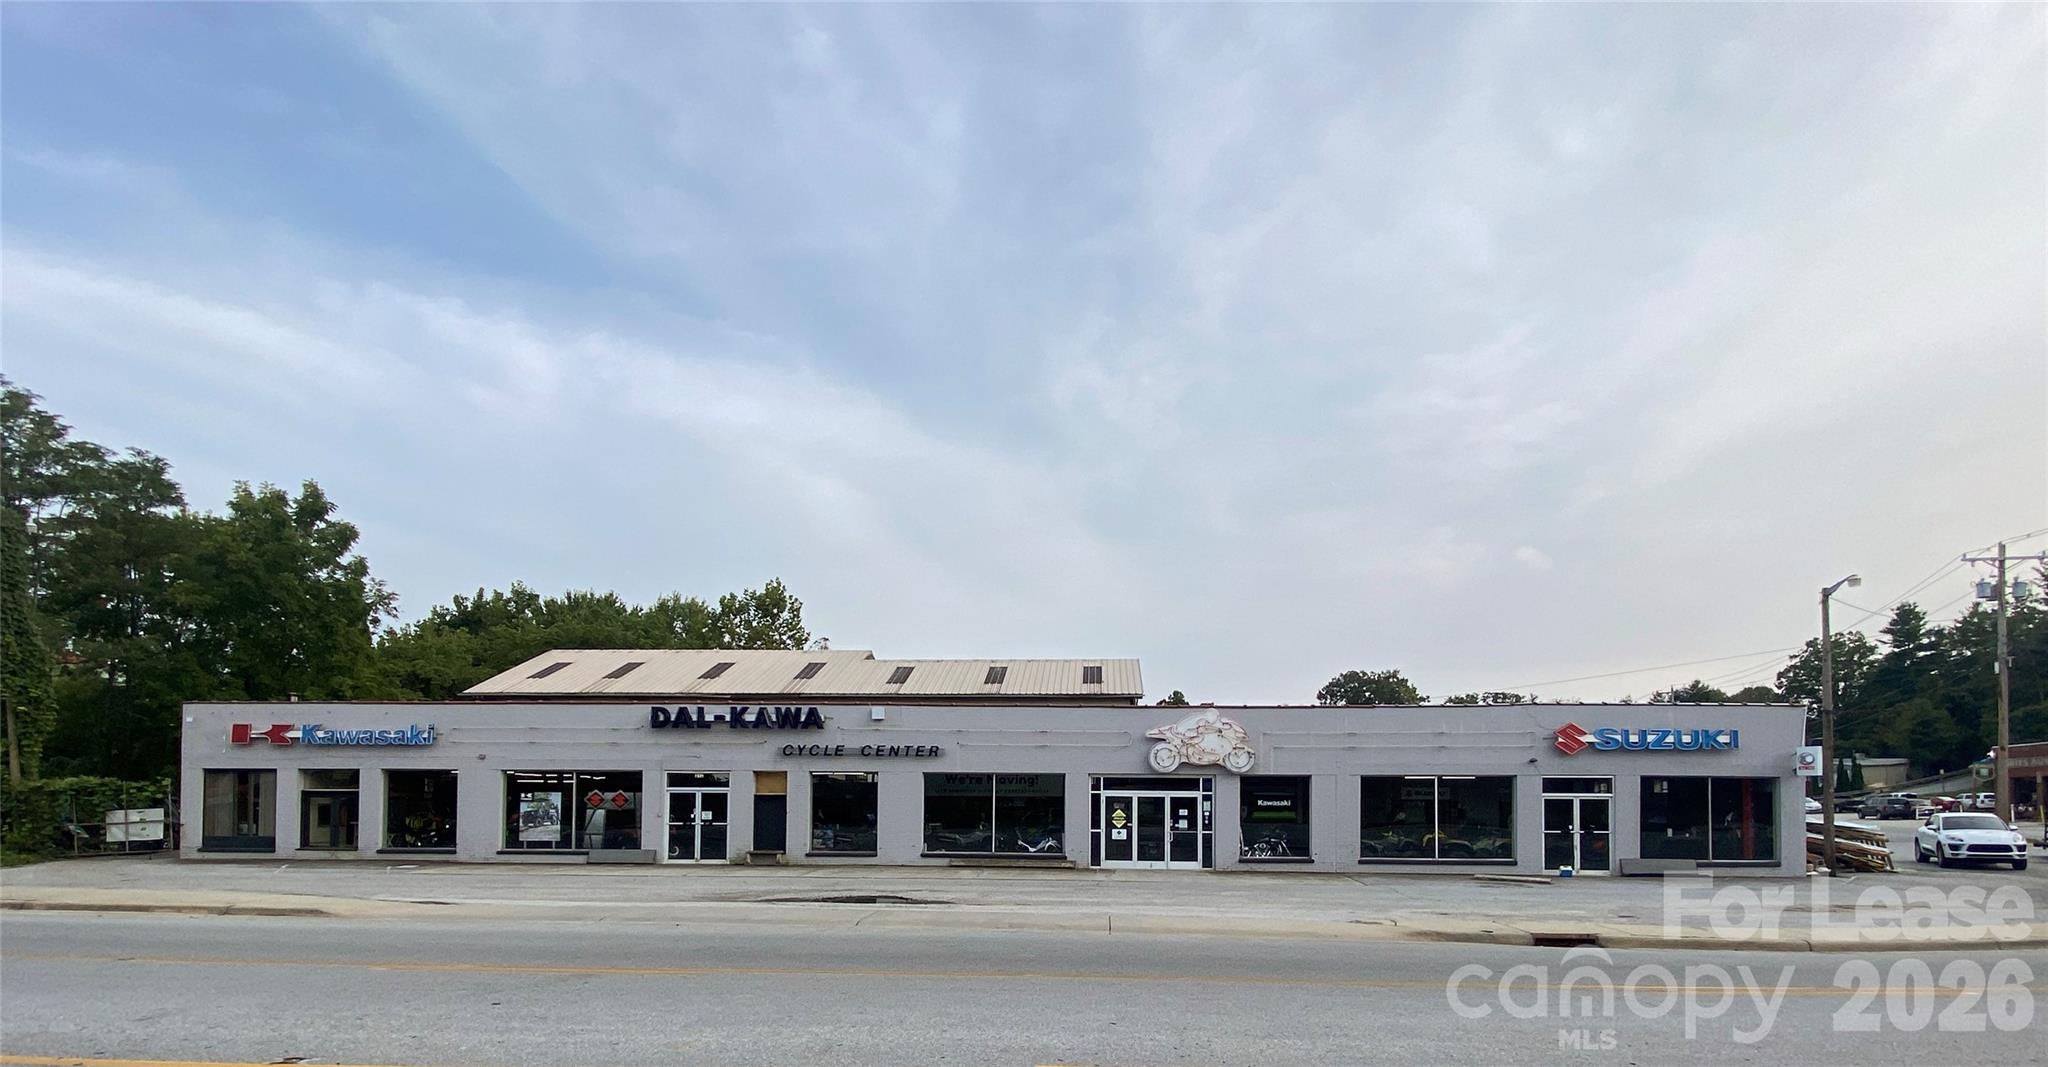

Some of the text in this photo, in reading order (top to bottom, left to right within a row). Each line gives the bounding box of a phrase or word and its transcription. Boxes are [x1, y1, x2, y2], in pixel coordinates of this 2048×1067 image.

[650, 706, 825, 730] DAL-KAWA
[300, 723, 436, 746] Kawasaki
[1593, 727, 1739, 751] SUZUKI
[782, 745, 941, 758] CYCLE CENTER
[945, 774, 1039, 787] We're Moving!
[1257, 799, 1291, 807] Kawasaki
